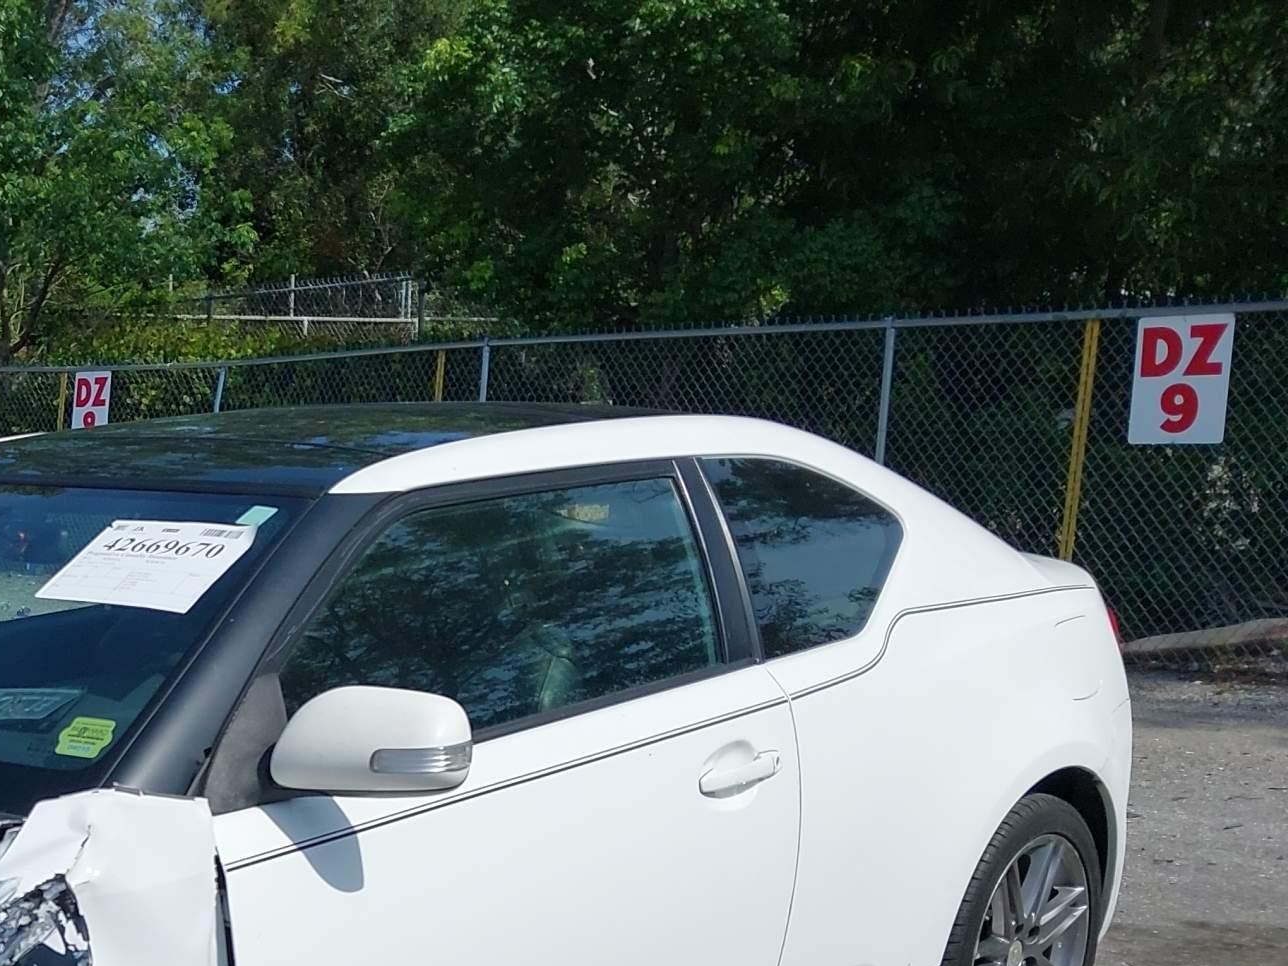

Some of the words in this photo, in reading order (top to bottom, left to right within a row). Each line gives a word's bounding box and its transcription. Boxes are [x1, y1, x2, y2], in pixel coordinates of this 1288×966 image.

[1140, 323, 1229, 378] DZ
[75, 376, 109, 408] DZ
[1159, 383, 1199, 433] 9
[103, 537, 225, 559] 42669670
